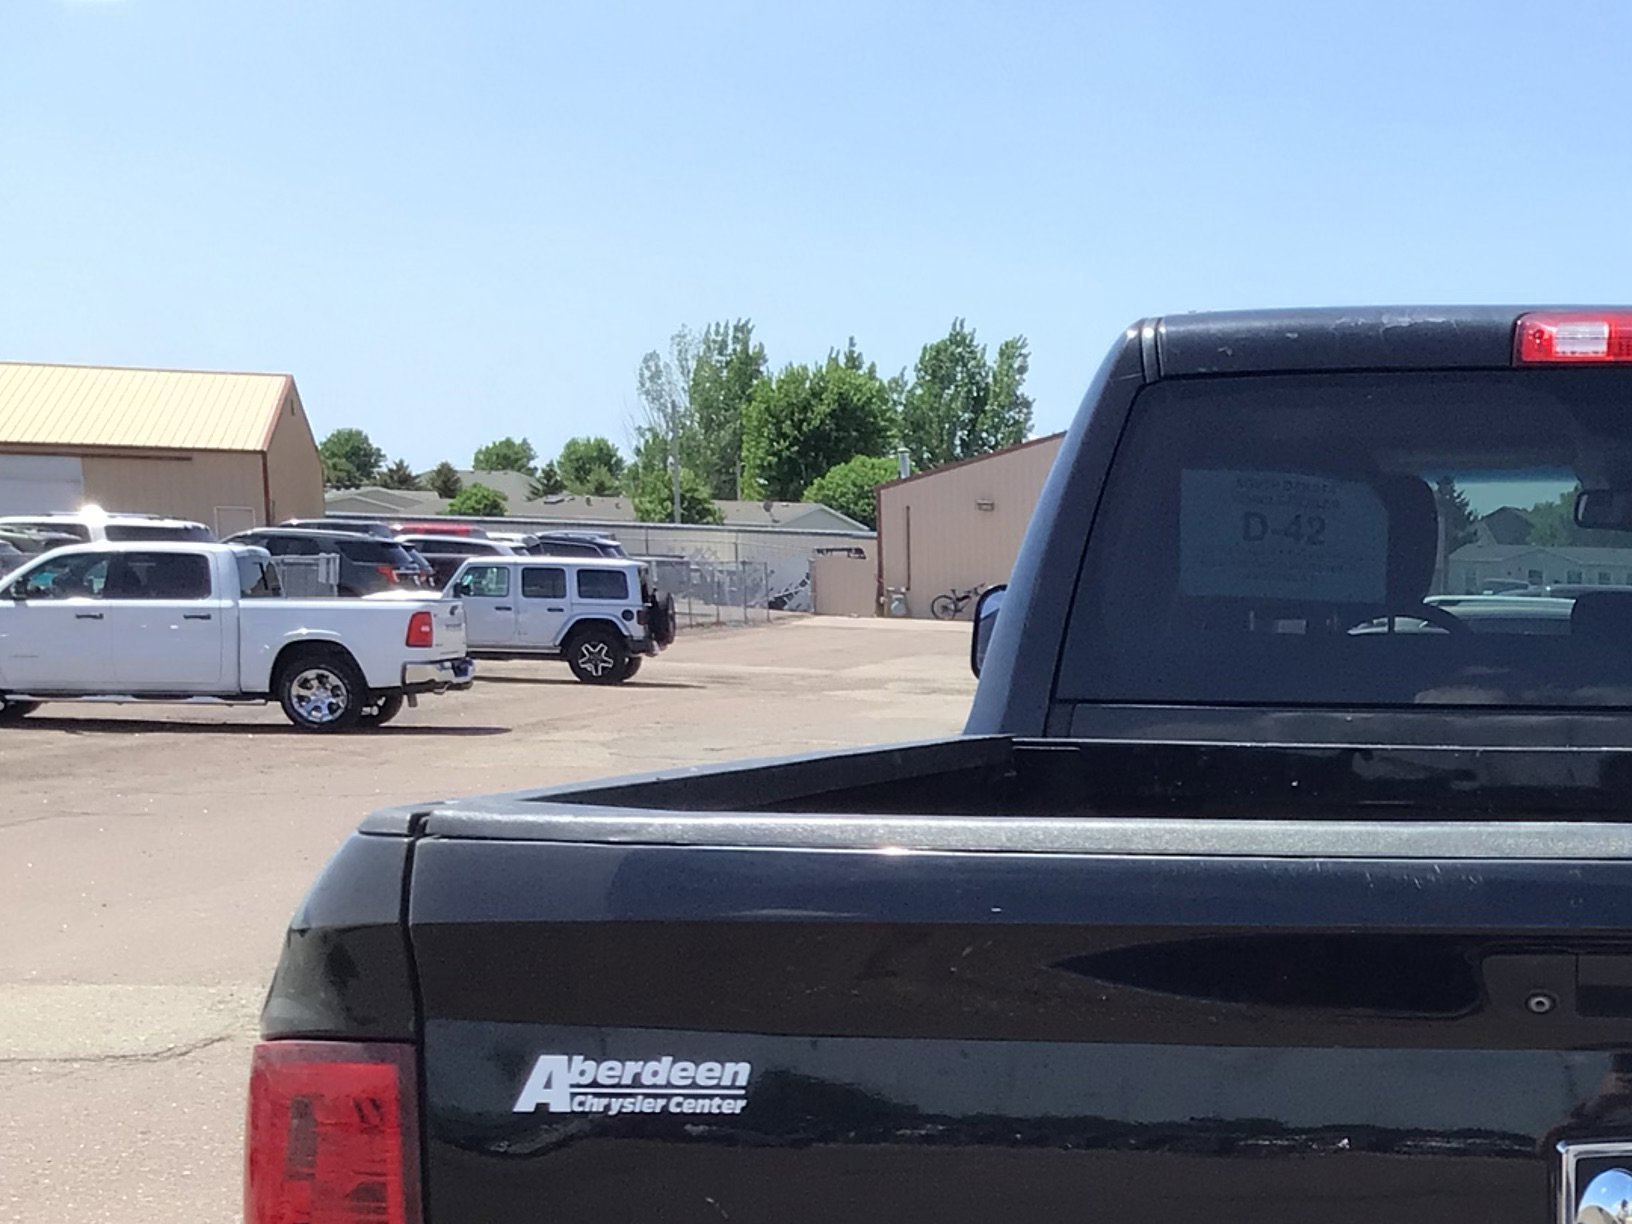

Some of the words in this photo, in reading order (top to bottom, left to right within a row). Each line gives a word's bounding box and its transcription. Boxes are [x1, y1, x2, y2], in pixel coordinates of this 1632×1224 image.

[1242, 511, 1326, 546] D-42
[512, 1054, 751, 1112] Aberdeen
[571, 1095, 667, 1116] Chrysler
[668, 1095, 747, 1115] Center
